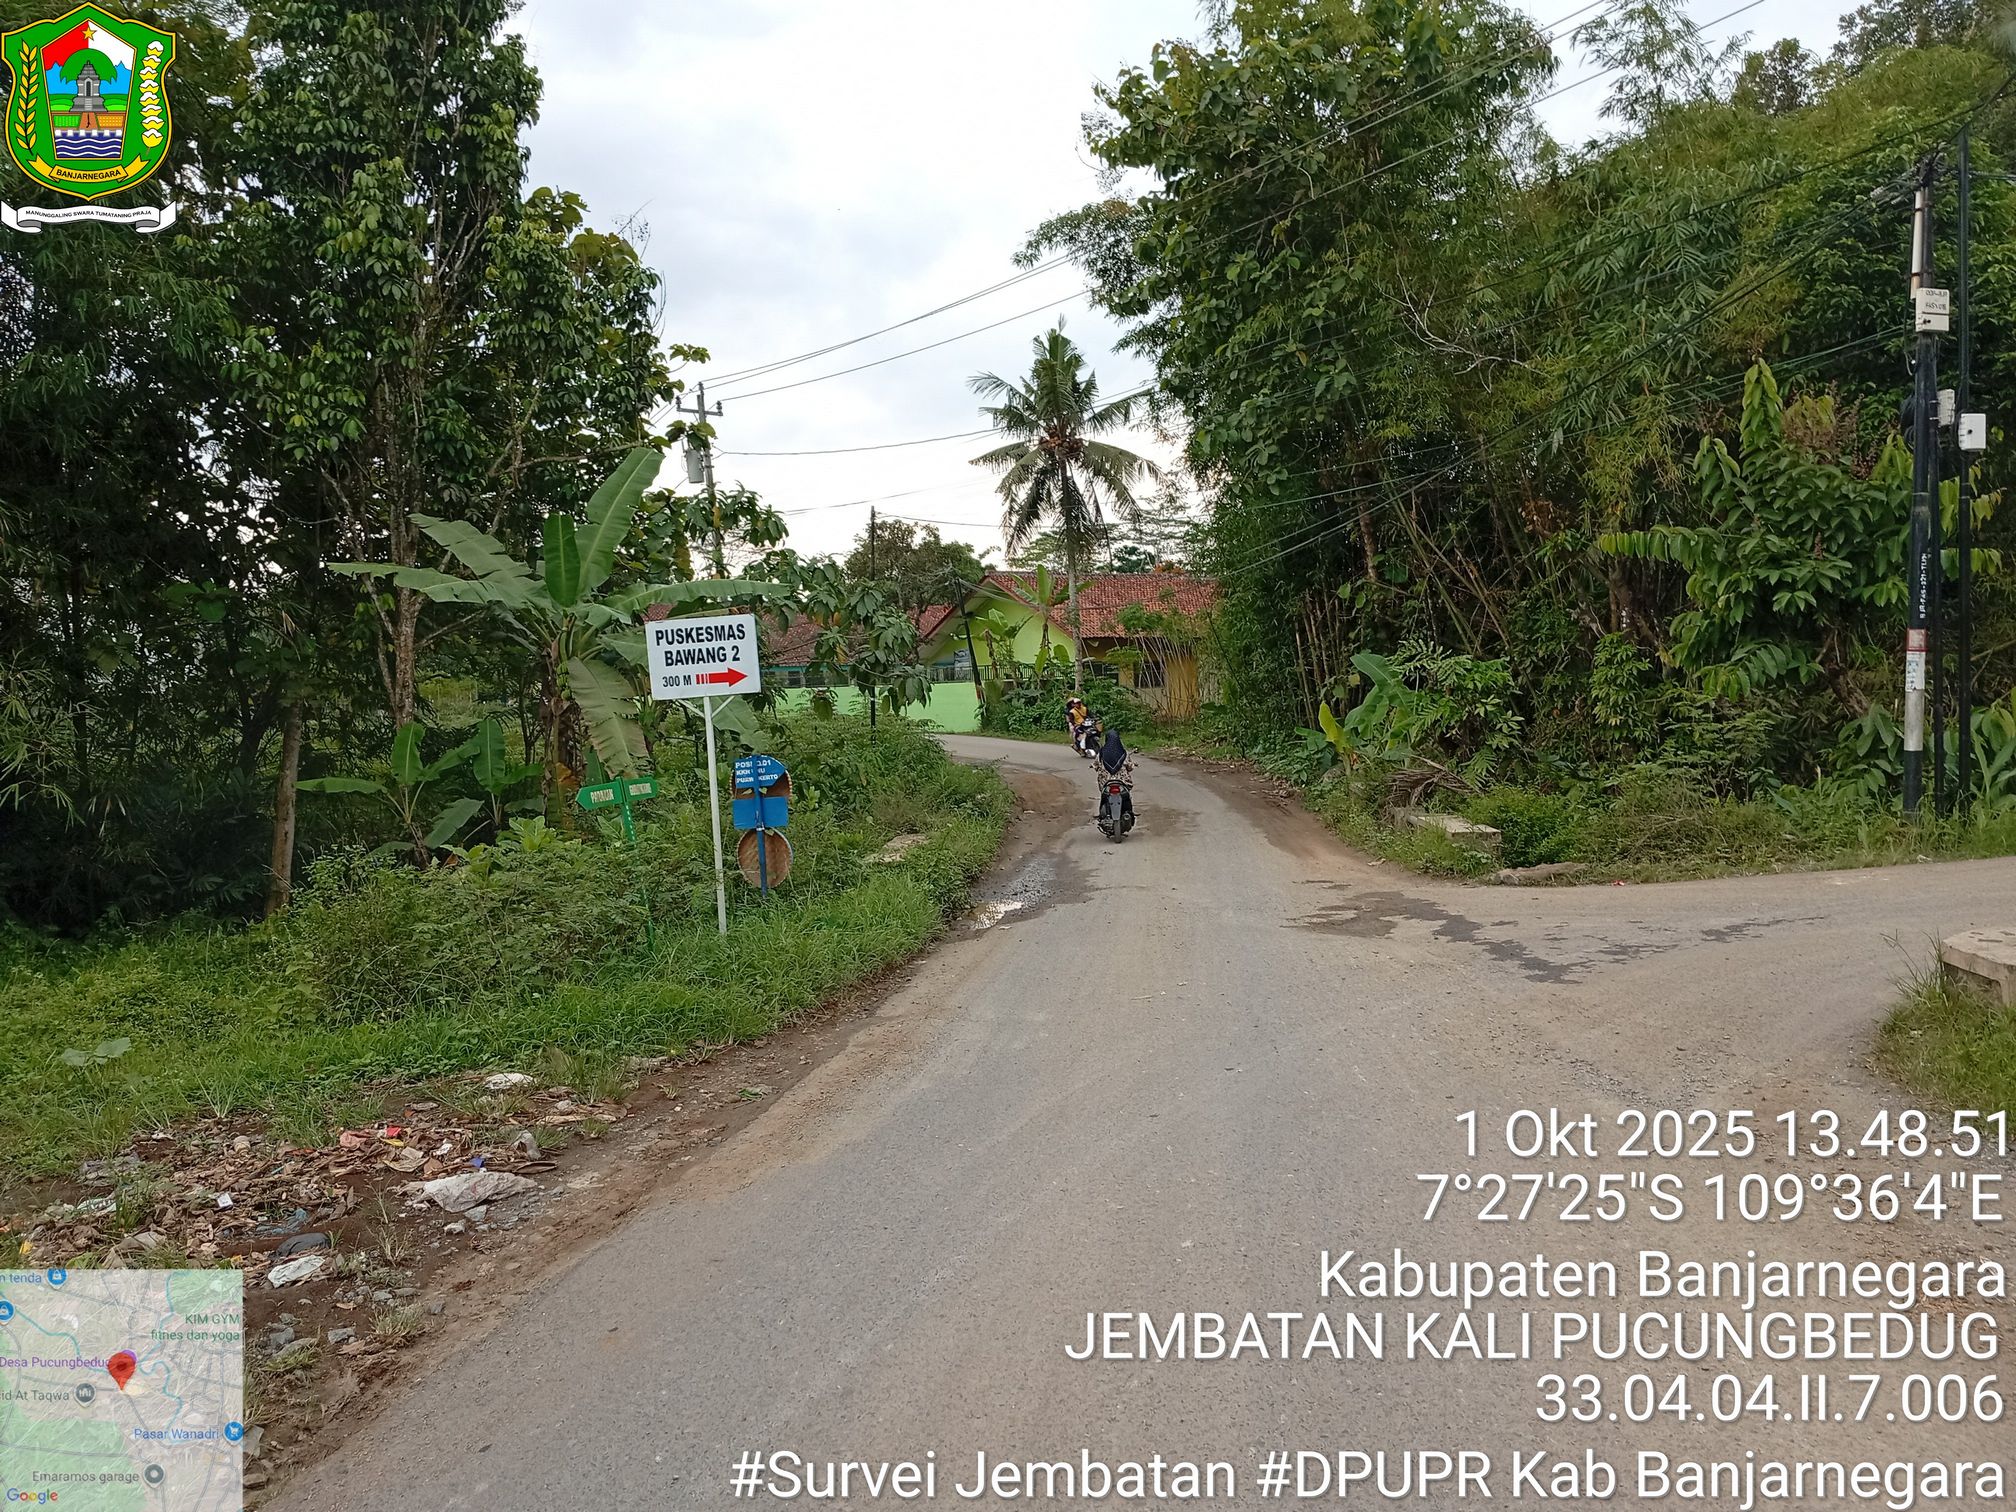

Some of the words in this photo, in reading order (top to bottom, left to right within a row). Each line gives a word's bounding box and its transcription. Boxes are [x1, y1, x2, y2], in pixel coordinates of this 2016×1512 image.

[655, 623, 746, 646] PUSKESMAS
[664, 646, 727, 667] BAWANG
[731, 645, 741, 662] 2
[662, 675, 680, 688] 300
[683, 674, 692, 686] M
